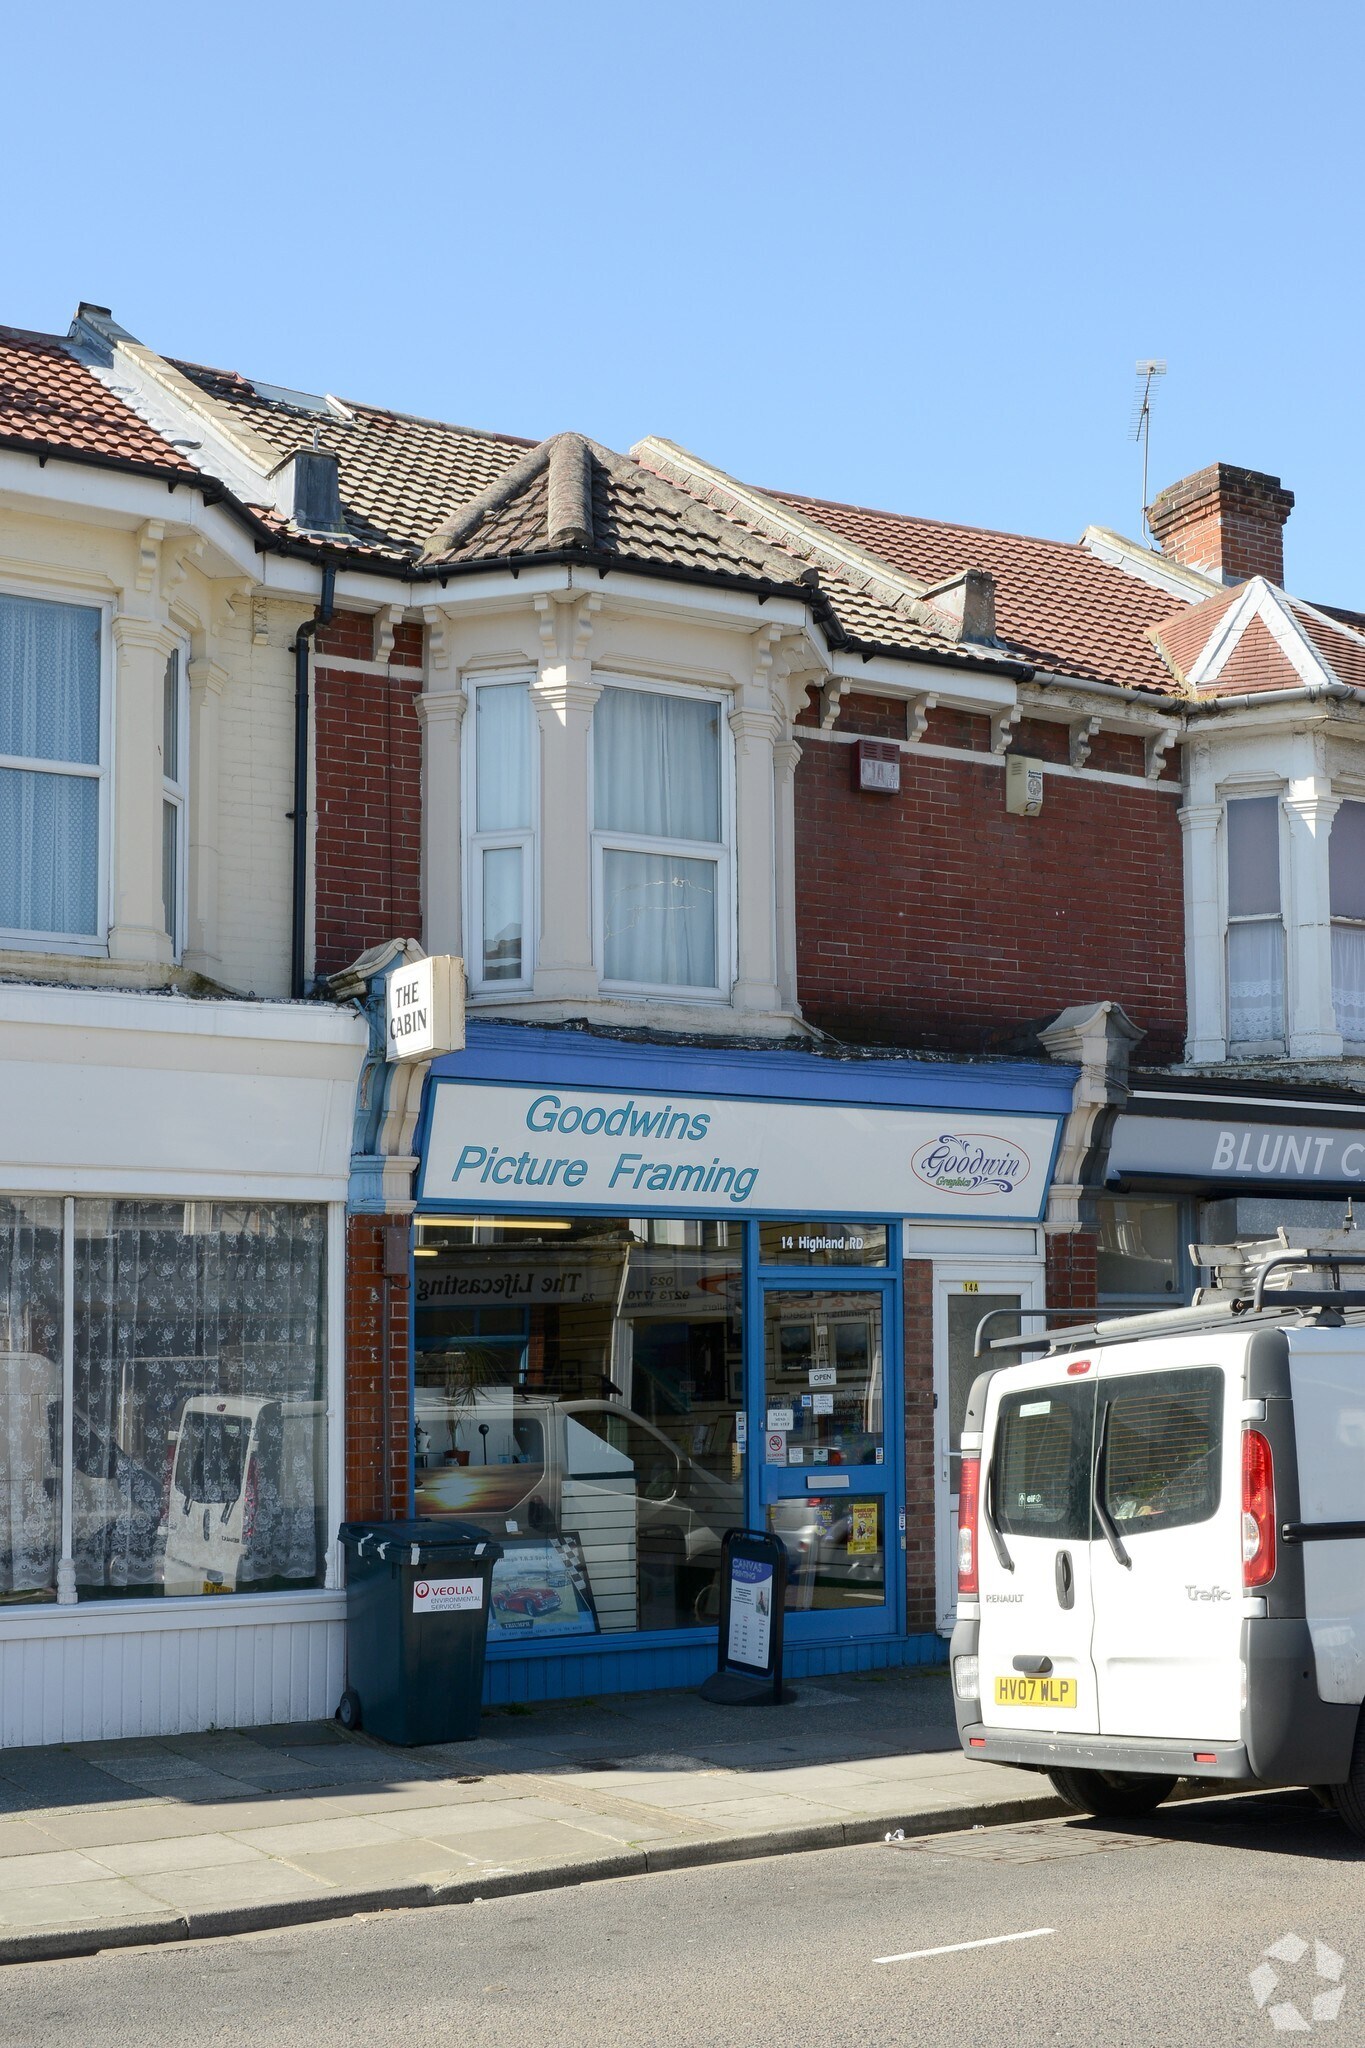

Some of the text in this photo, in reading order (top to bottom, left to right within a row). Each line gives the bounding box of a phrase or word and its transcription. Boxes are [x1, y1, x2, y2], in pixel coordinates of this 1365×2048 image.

[396, 981, 419, 1008] THE
[390, 1008, 427, 1040] CABIN
[526, 1094, 711, 1141] Goodwins
[921, 1145, 1020, 1178] Goodwin
[1211, 1131, 1334, 1175] BLUNT
[451, 1145, 759, 1203] Picture Framing
[936, 1176, 972, 1188] Graphics
[781, 1236, 864, 1253] 14 Highland RD
[964, 1283, 979, 1293] 14A
[813, 1373, 832, 1381] OPEN
[431, 1586, 473, 1596] VEOLIA
[986, 1594, 1024, 1603] RENAULT
[1184, 1585, 1232, 1602] Trafic
[430, 1596, 481, 1604] ENVIRONMENTAL
[999, 1679, 1069, 1702] HV07 WLP
